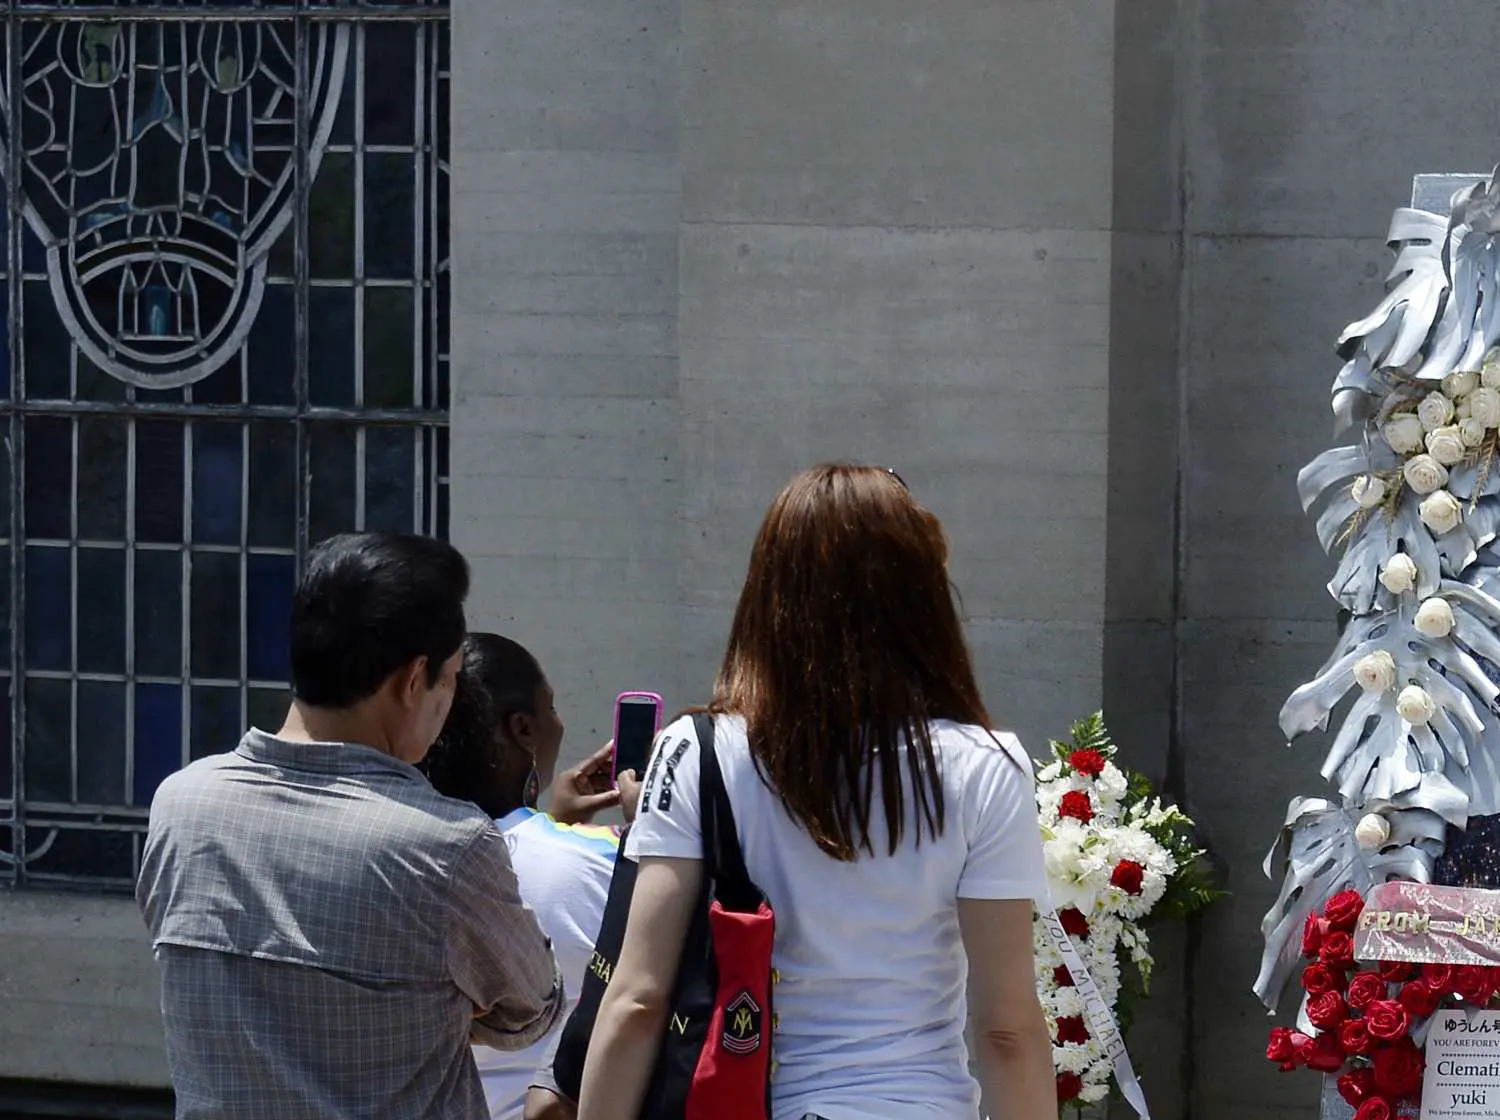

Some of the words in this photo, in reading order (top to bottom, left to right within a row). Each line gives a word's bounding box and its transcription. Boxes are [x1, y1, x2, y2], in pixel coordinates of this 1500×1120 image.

[1043, 912, 1072, 953] YOU
[1360, 911, 1431, 934] FROM
[1434, 1039, 1452, 1047] YOU
[1450, 1090, 1486, 1109] yuki
